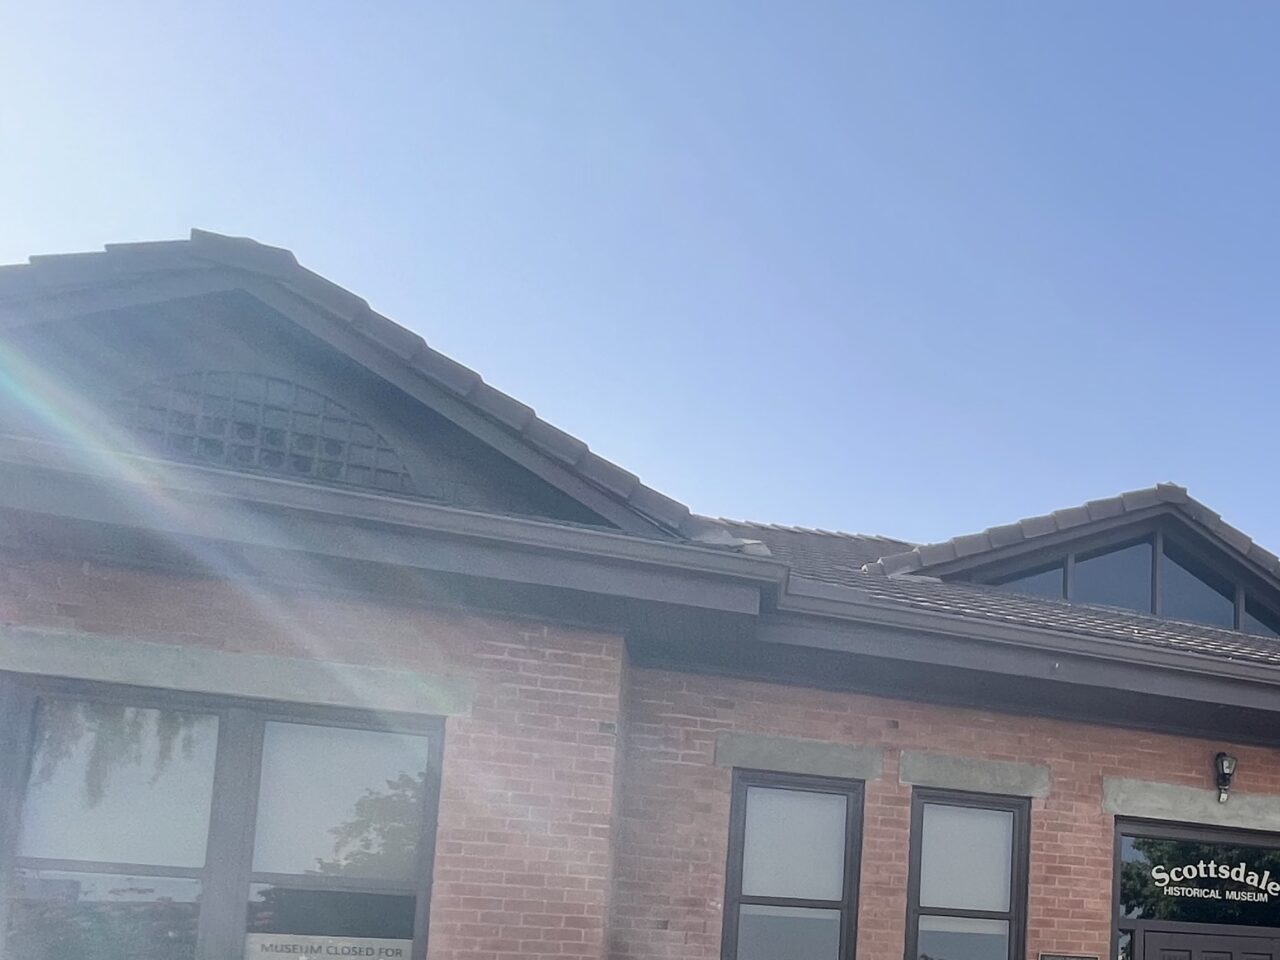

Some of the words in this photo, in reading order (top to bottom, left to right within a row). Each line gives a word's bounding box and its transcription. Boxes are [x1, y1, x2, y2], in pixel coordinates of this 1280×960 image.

[1151, 860, 1280, 896] Scottsdale
[1163, 886, 1222, 899] HISTORICAL
[1225, 890, 1268, 902] MUSEUM
[260, 943, 323, 955] MUSEUM
[326, 945, 375, 957] CLOSED
[378, 947, 403, 958] FOR
